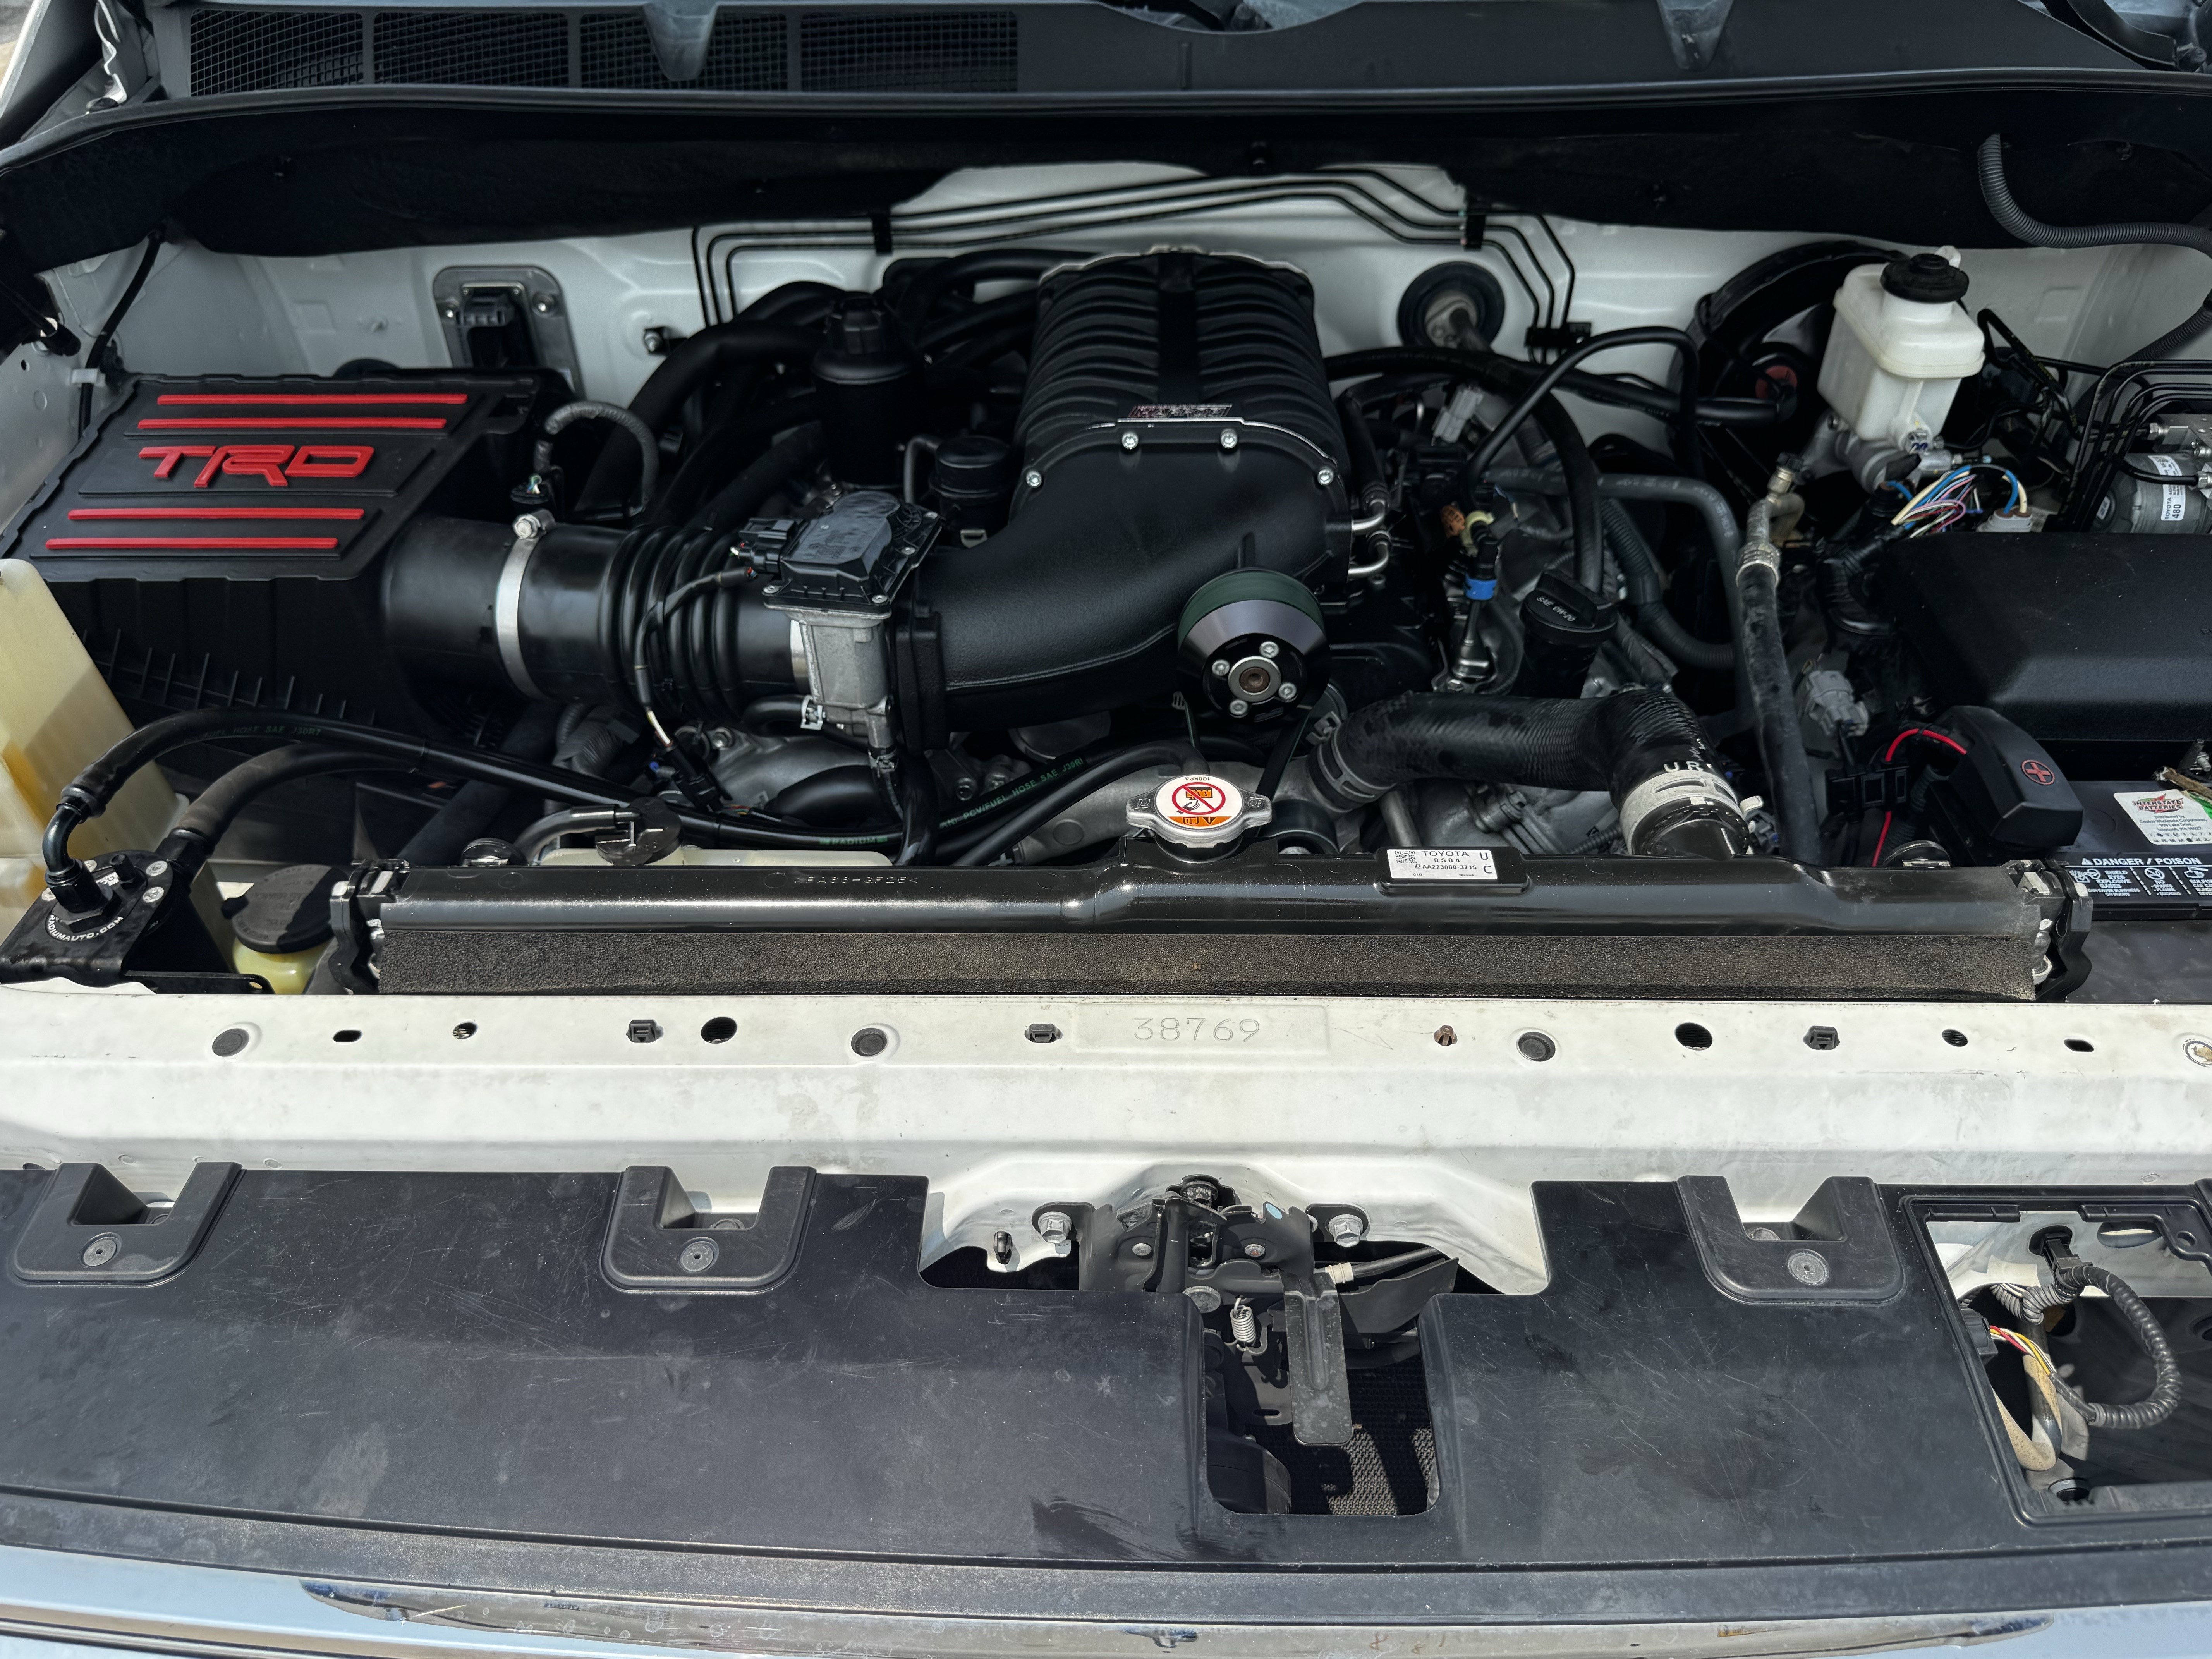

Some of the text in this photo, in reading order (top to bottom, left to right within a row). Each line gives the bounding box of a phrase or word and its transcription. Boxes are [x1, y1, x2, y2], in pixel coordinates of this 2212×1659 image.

[138, 445, 374, 488] TRD
[2172, 504, 2181, 519] 480
[1536, 596, 1554, 606] SAE
[1012, 779, 1037, 797] HOSE
[1040, 769, 1058, 782] SAE
[2132, 798, 2183, 806] INTERSTATE
[831, 836, 875, 845] RADIUM
[1479, 852, 1488, 860] U
[1483, 865, 1492, 874] C
[1133, 1018, 1259, 1042] 38769
